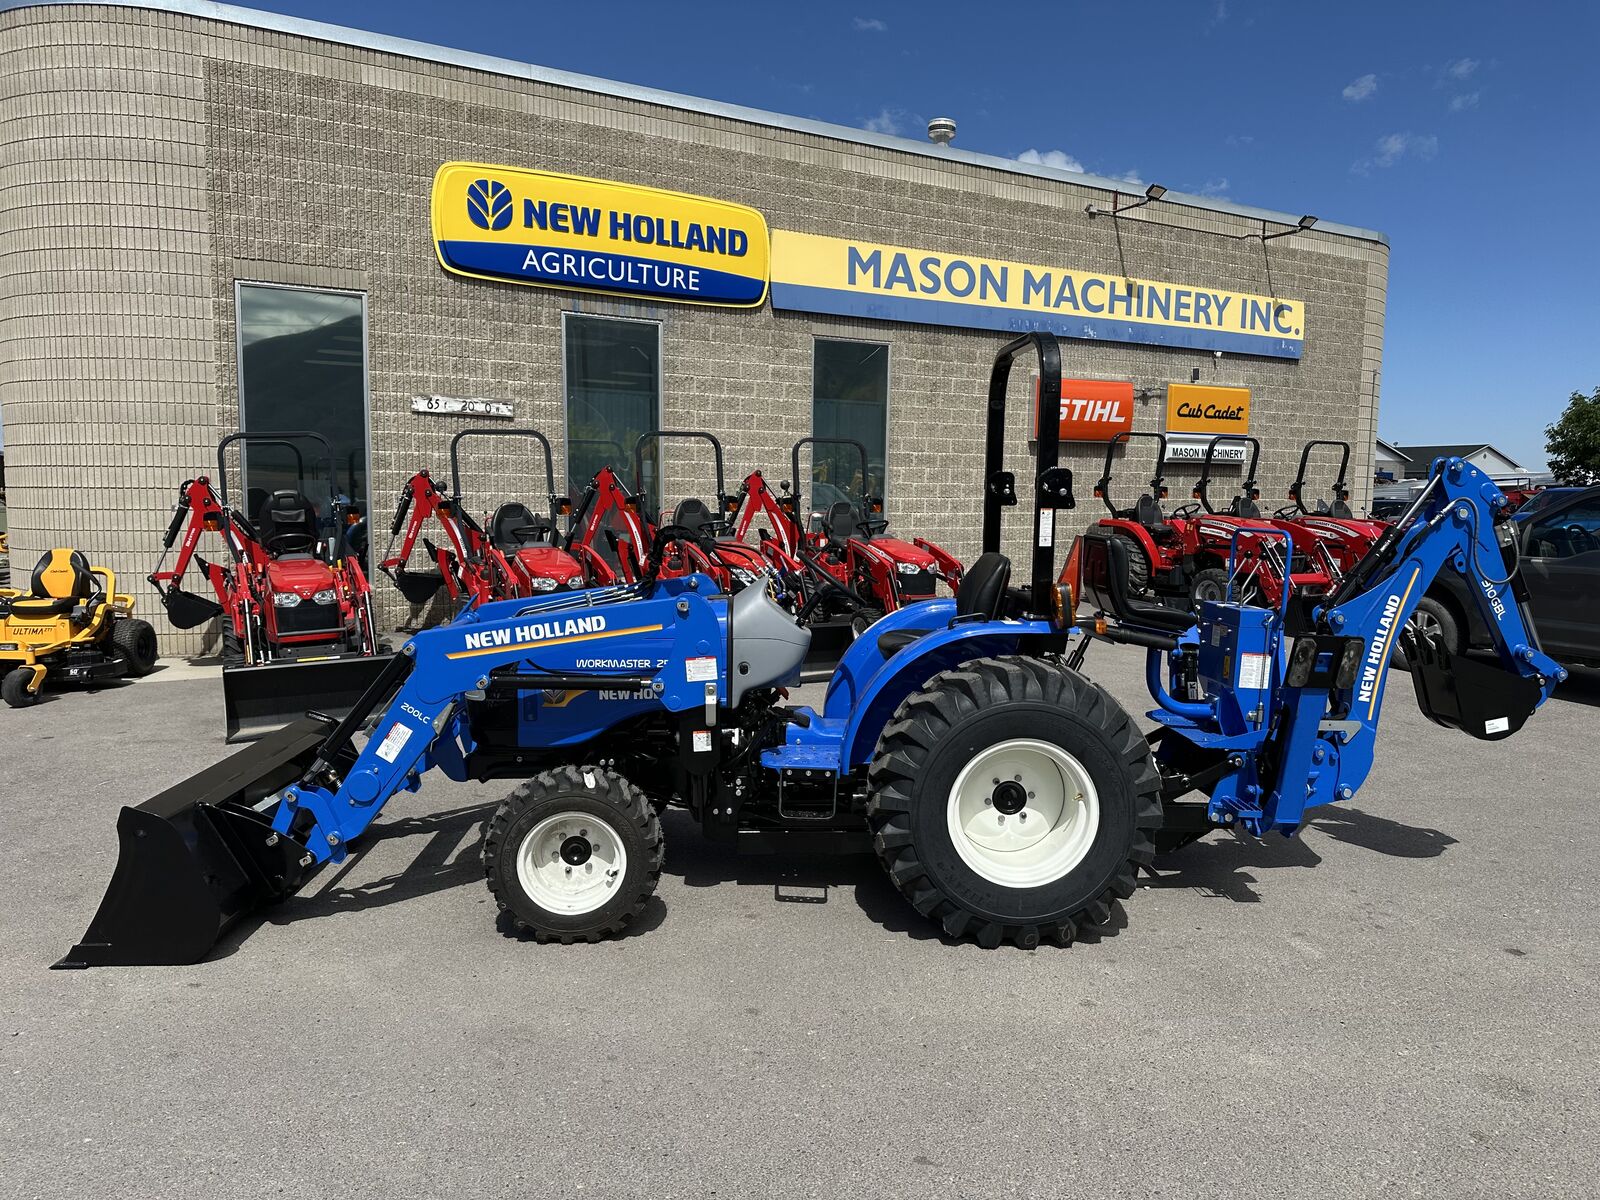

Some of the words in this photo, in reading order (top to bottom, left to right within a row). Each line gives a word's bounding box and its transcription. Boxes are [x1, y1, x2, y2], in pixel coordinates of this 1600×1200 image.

[523, 198, 601, 237] NEW
[609, 211, 748, 257] HOLLAND
[522, 249, 700, 291] AGRICULTURE
[847, 245, 1008, 301] MASON
[1023, 271, 1231, 326] MACHINERY
[1240, 298, 1300, 335] INC.
[1060, 398, 1126, 423] STIHL
[1177, 403, 1202, 418] Cub
[1203, 404, 1244, 420] Cadet
[1172, 447, 1200, 458] MASON
[1202, 449, 1244, 459] MCHINERY
[13, 627, 44, 635] ULTIMA
[465, 628, 511, 649] NEW
[515, 615, 606, 642] HOLLAND
[1358, 666, 1376, 702] NEW
[1368, 595, 1400, 664] HOLLAND
[576, 659, 650, 668] WORKMASTER
[599, 689, 630, 700] NEW
[400, 702, 430, 724] 200LC
